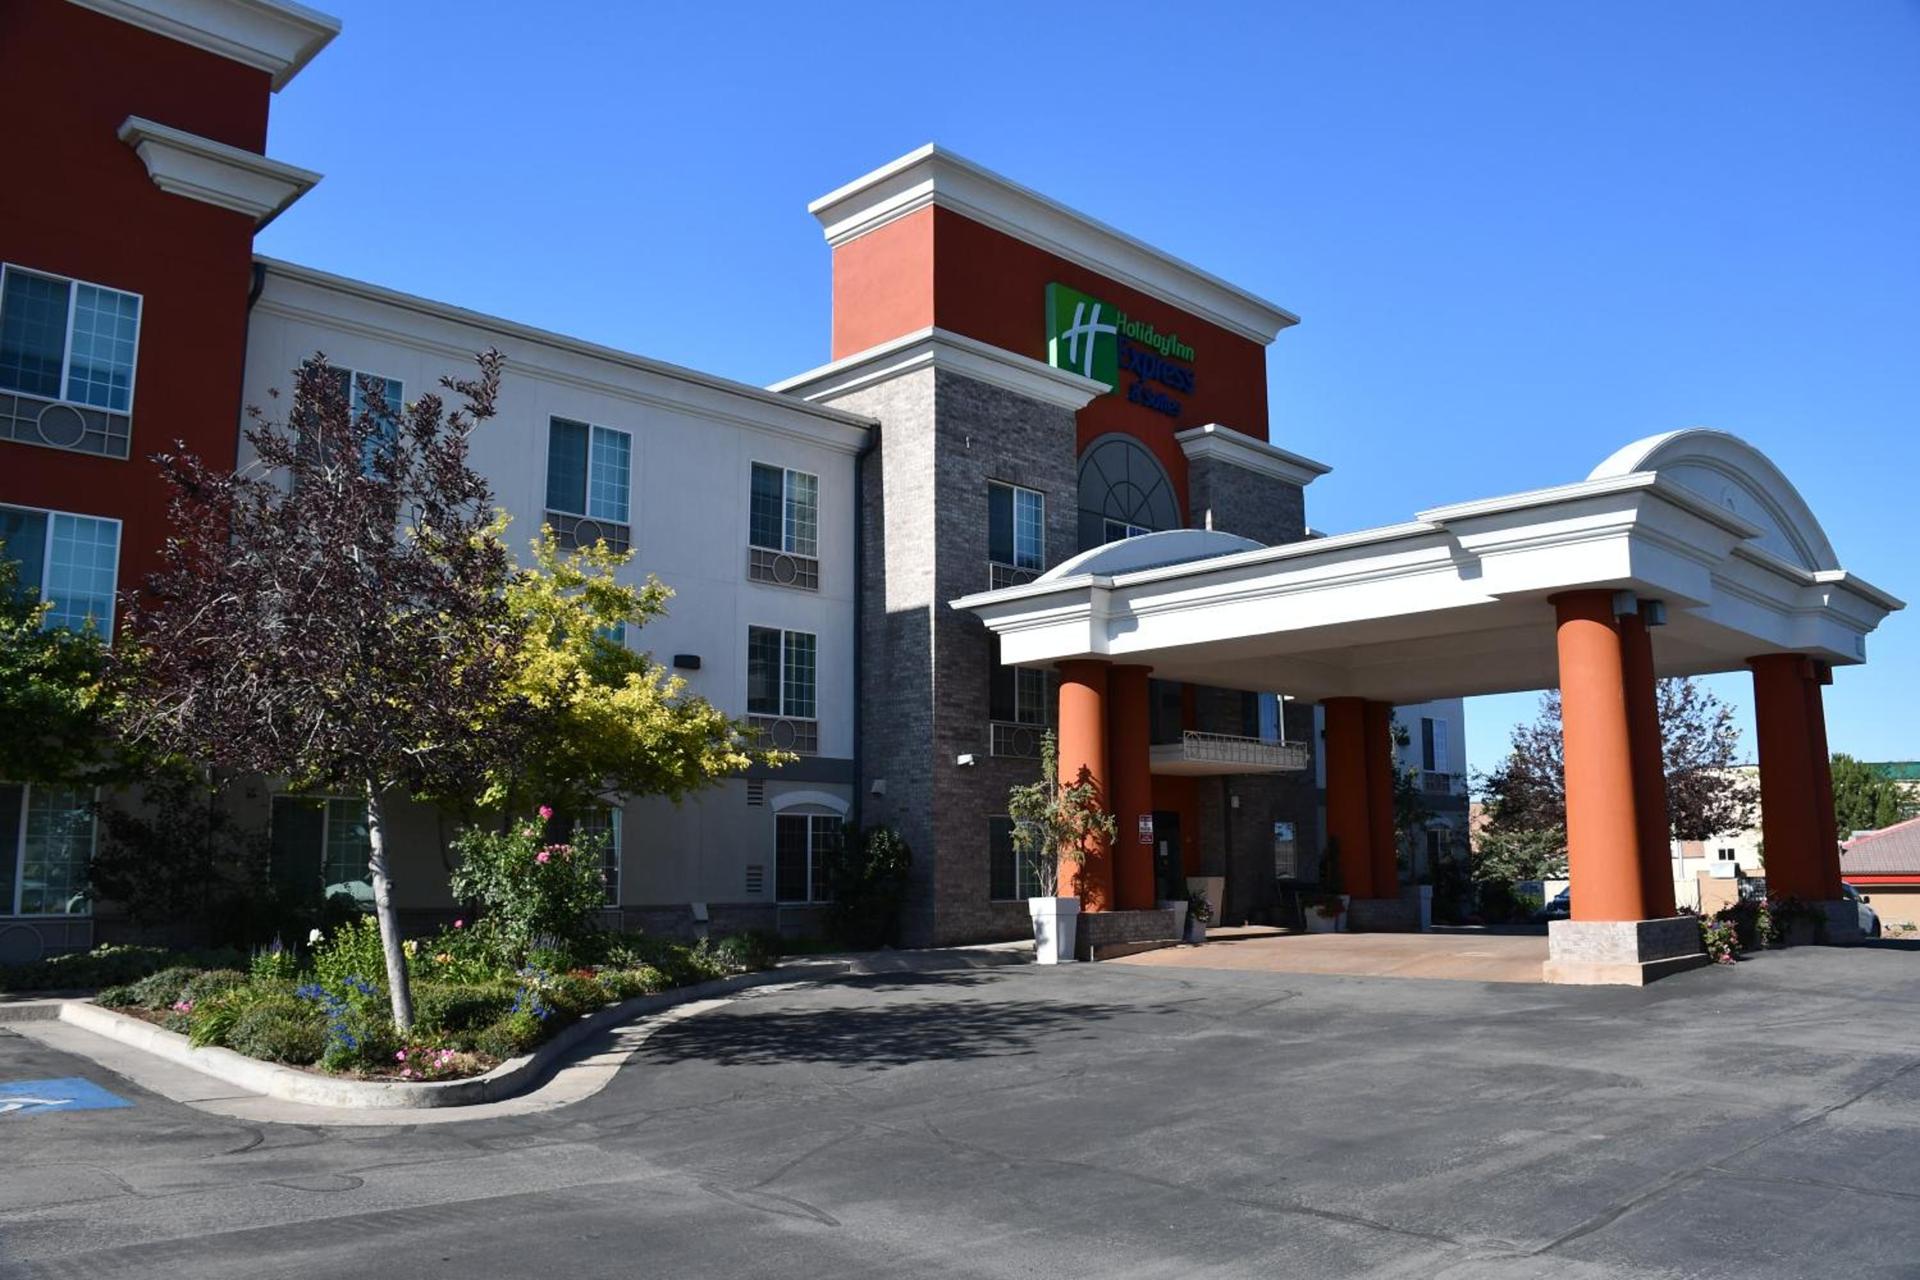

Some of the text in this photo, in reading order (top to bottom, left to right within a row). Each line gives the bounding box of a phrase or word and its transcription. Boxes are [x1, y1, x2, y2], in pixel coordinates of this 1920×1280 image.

[1117, 311, 1195, 362] Holiday Inn
[1118, 336, 1195, 395] Express
